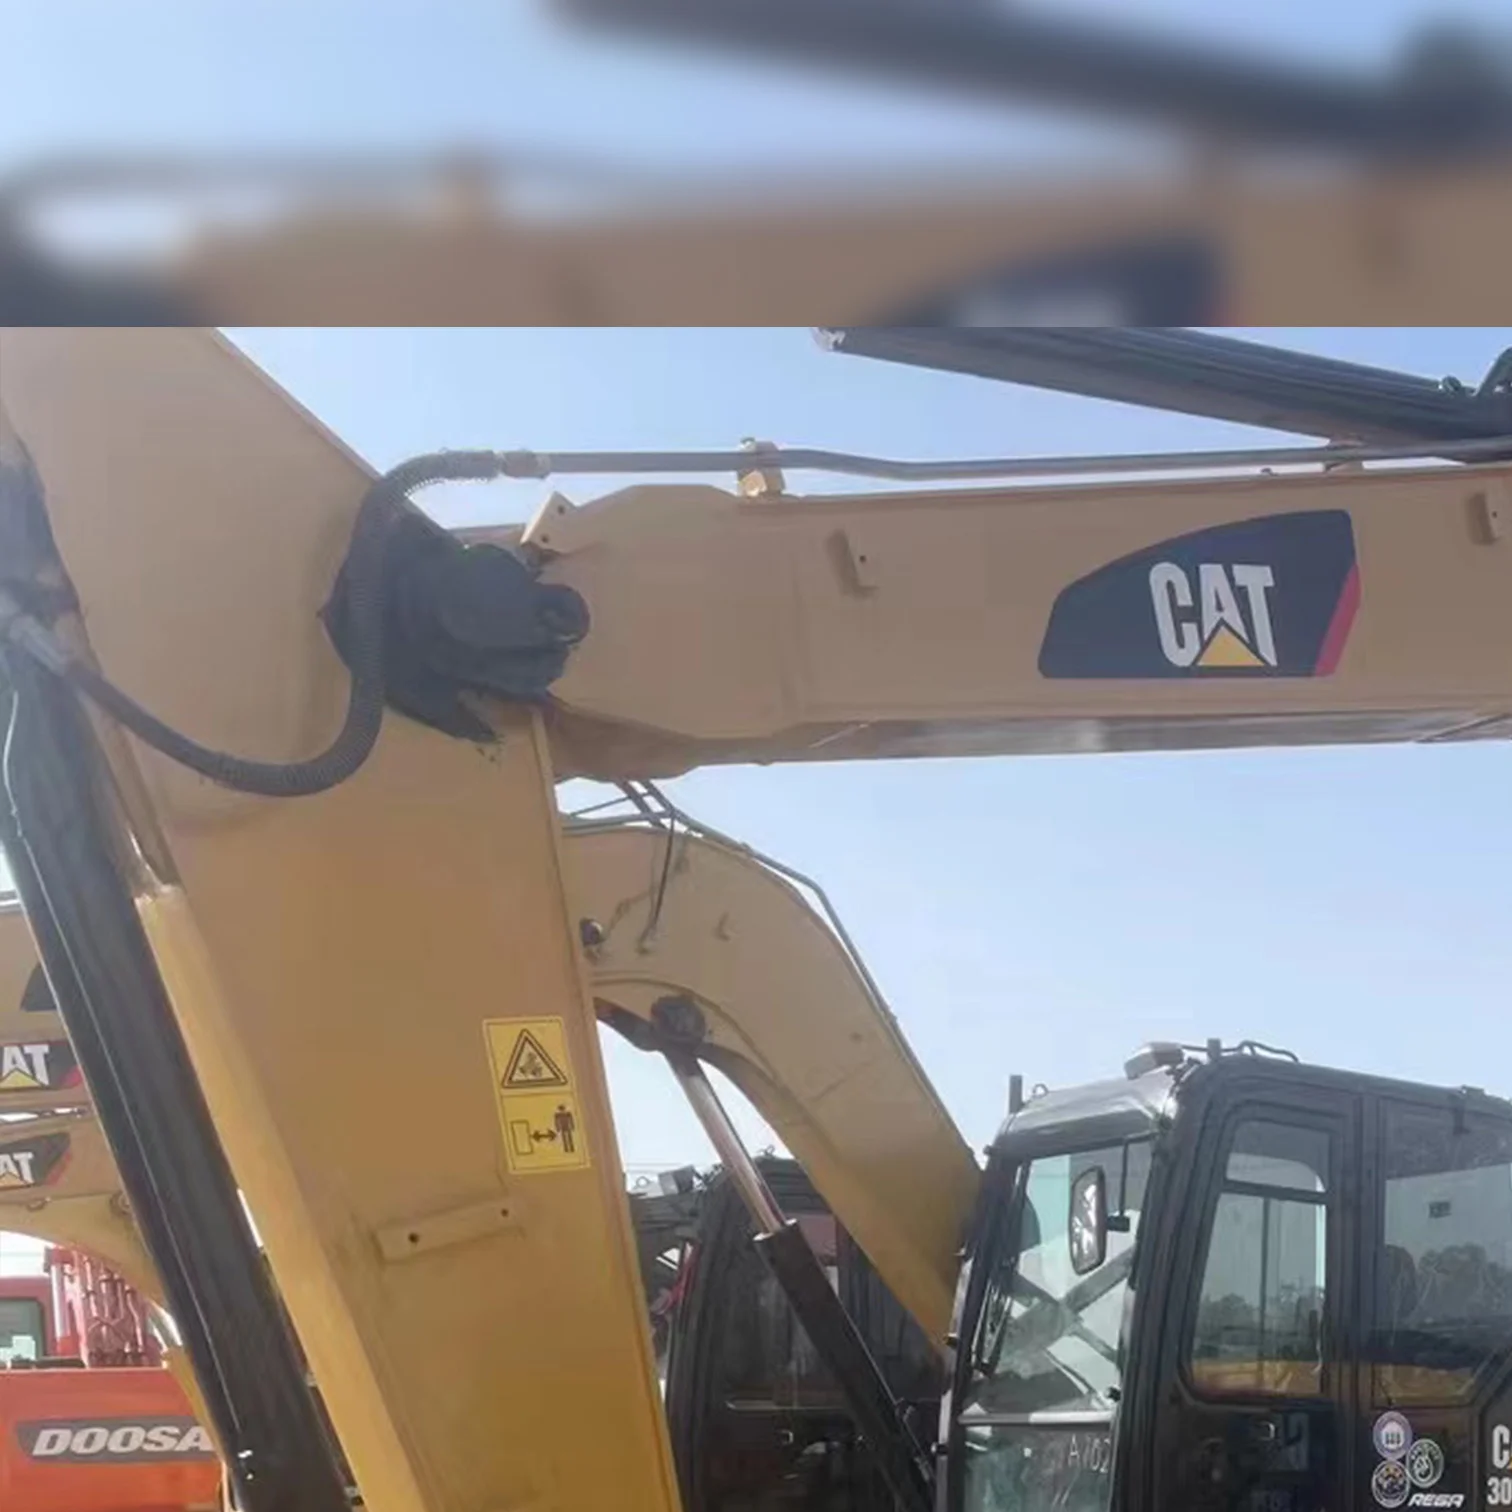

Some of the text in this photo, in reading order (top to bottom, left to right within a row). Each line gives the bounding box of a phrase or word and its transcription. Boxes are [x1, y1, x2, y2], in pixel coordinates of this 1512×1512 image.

[1149, 561, 1278, 668] CAT
[0, 1043, 50, 1087] AT
[0, 1152, 35, 1185] AT
[32, 1426, 215, 1456] DOOSA
